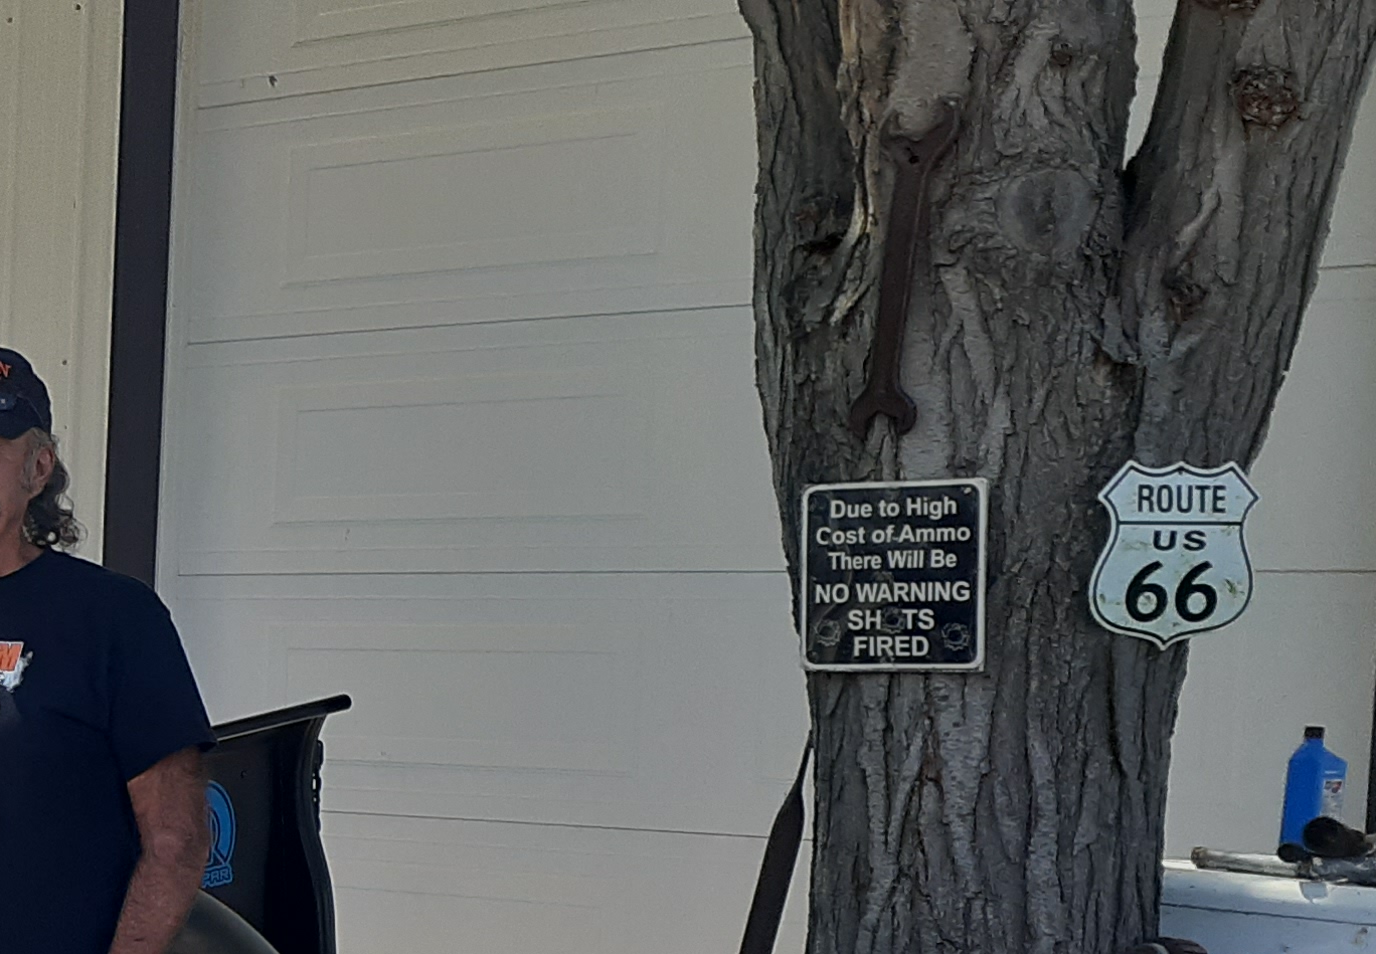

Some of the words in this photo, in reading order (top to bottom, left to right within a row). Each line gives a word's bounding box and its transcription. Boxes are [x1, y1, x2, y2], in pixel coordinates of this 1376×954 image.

[830, 500, 873, 519] Due
[879, 500, 900, 517] to
[906, 496, 957, 520] High
[1137, 484, 1227, 514] ROUTE
[816, 527, 866, 545] Cost
[872, 525, 895, 543] of
[899, 524, 971, 543] Ammo
[1153, 530, 1207, 551] US
[828, 552, 882, 570] There
[888, 550, 924, 568] Will
[930, 549, 958, 568] Be
[815, 583, 850, 604] NO
[856, 581, 971, 603] WARNING
[1125, 560, 1218, 623] 66
[853, 635, 930, 657] FIRED
